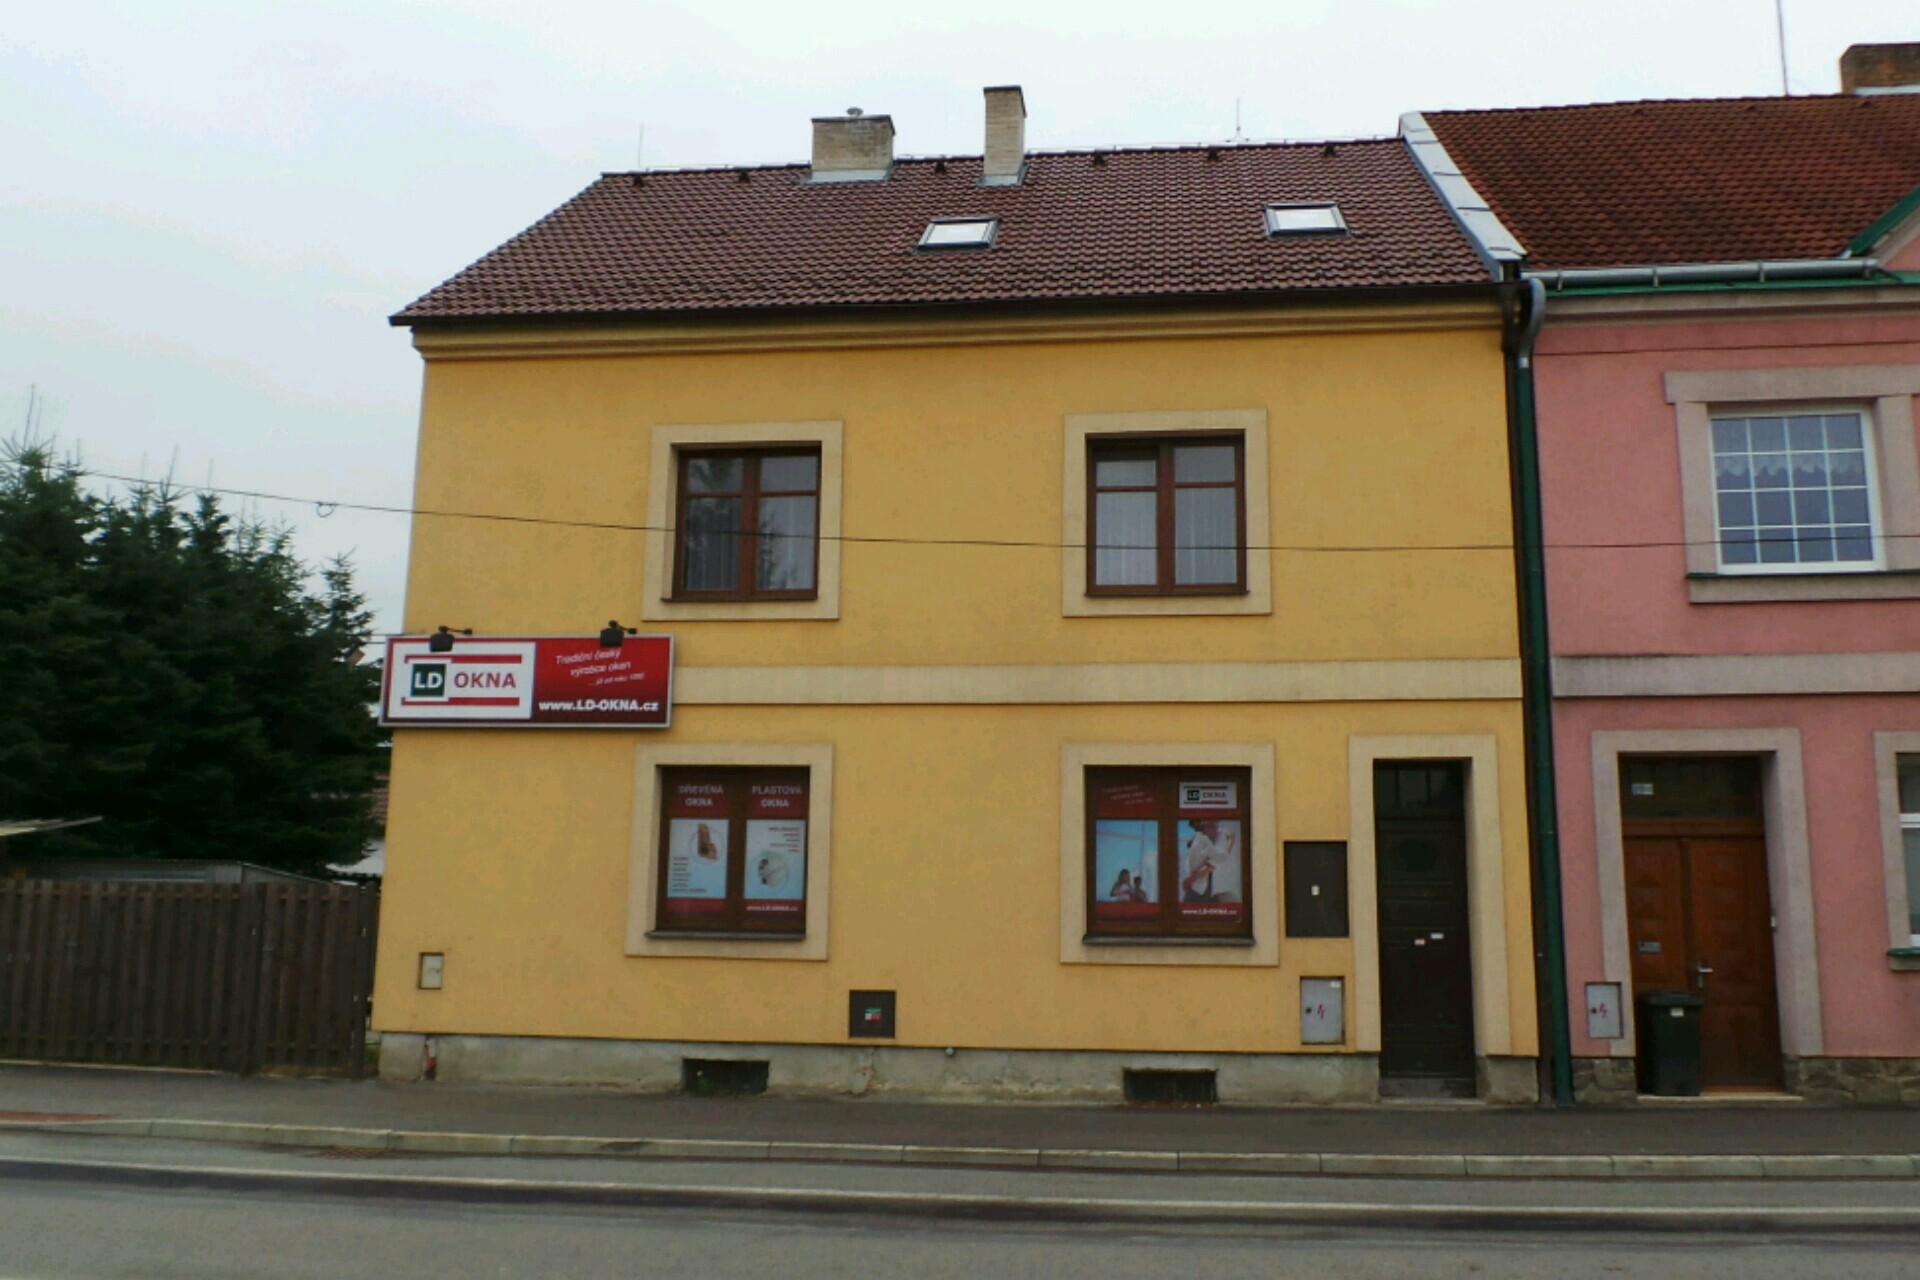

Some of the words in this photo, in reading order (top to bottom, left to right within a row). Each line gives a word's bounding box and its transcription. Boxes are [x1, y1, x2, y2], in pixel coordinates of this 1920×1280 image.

[414, 672, 443, 689] LD
[454, 672, 517, 688] OKNA
[539, 699, 659, 711] www.LD-OKNA.cz
[685, 797, 713, 807] OKNA
[761, 798, 789, 808] OKNA
